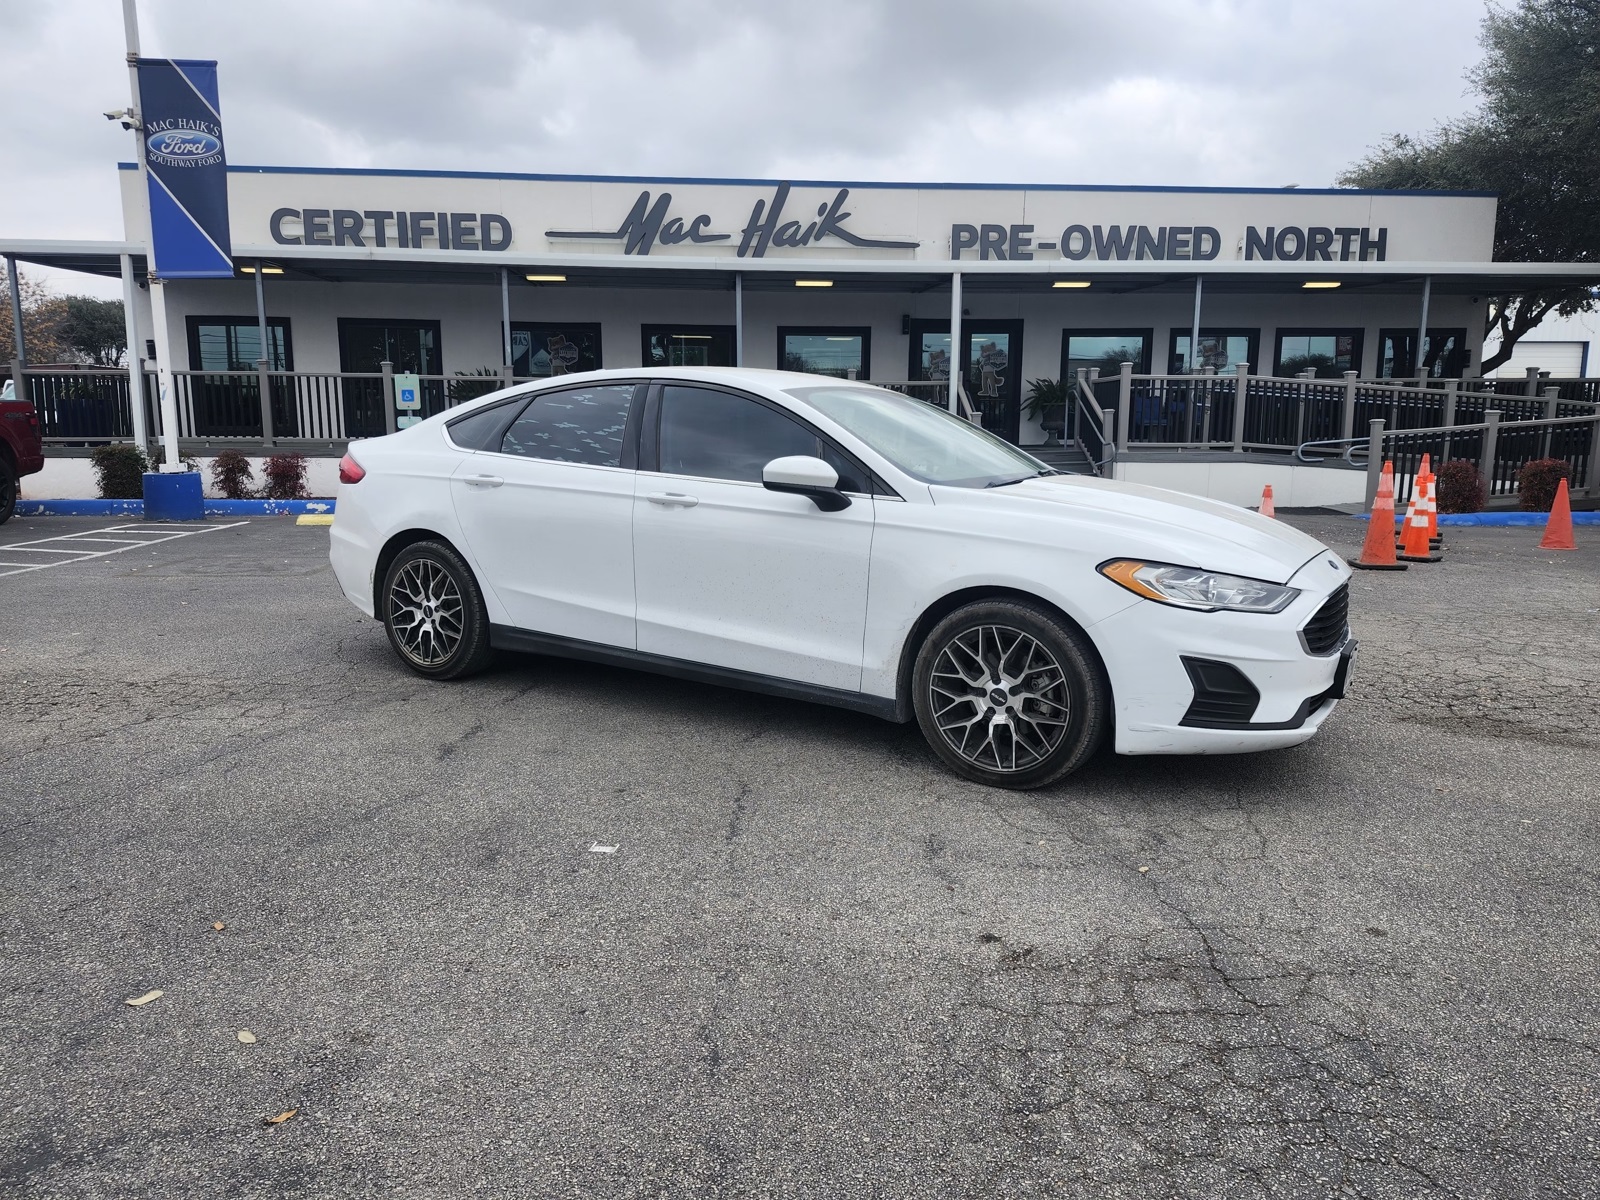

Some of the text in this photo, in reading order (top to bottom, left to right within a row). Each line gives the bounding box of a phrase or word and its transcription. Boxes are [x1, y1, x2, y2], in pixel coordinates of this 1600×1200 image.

[146, 118, 220, 137] MAC HAIK'S
[161, 134, 206, 153] Ford
[148, 152, 221, 167] SOUTHWAY FORD
[269, 207, 513, 252] CERTIFIED
[545, 180, 921, 258] Mac Haik
[951, 223, 1389, 262] PRE-OWNED NORTH
